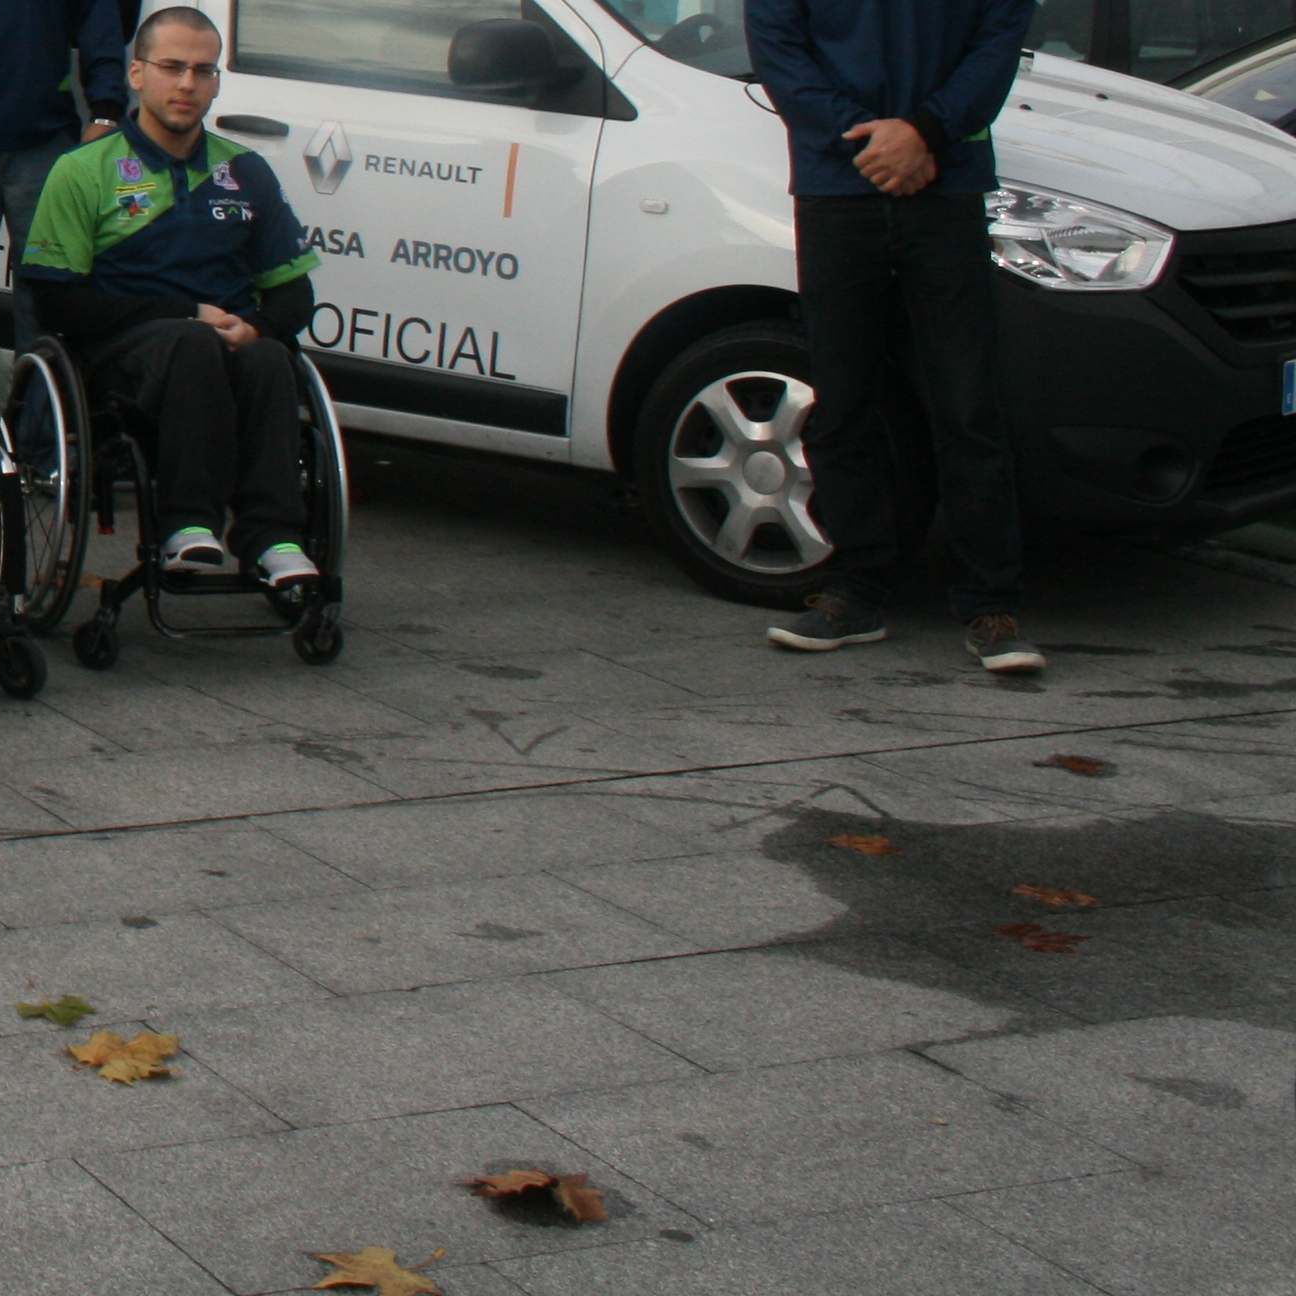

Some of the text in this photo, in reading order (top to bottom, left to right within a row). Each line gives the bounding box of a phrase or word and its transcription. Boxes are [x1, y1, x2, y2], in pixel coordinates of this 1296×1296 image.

[365, 154, 483, 185] RENAULT
[390, 238, 519, 281] ARROYO
[308, 301, 517, 381] OFICIAL
